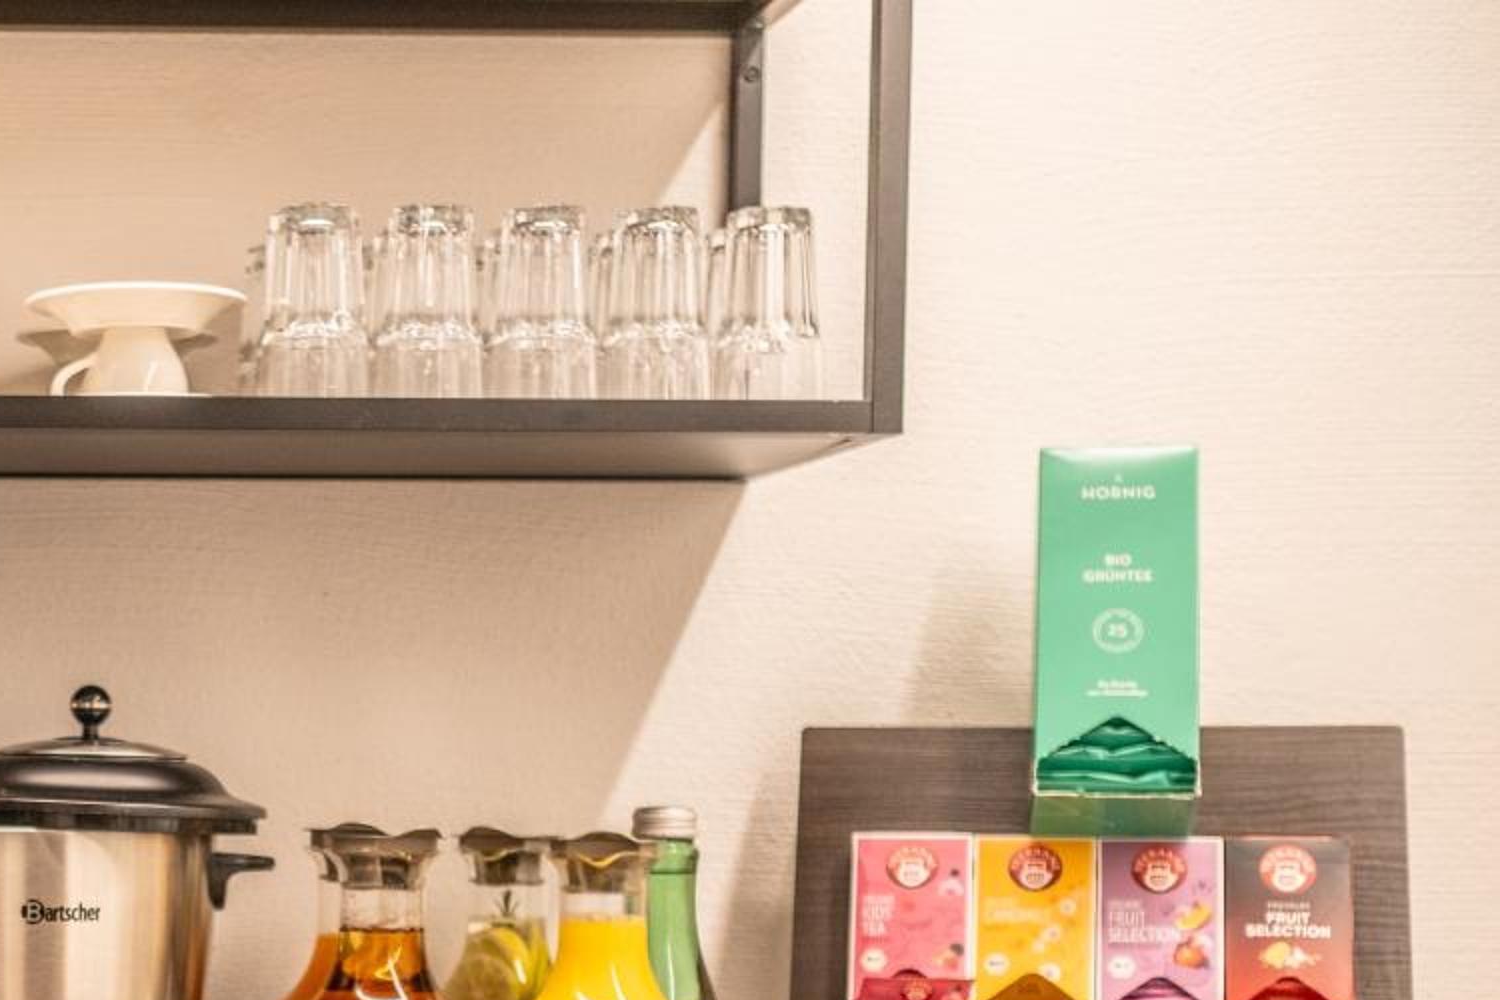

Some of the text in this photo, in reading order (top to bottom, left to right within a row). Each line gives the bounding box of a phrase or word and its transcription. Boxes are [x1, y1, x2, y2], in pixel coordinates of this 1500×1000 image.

[21, 899, 101, 925] Bartscher
[1265, 911, 1311, 925] FRUIT
[1245, 924, 1332, 939] SELECTION
